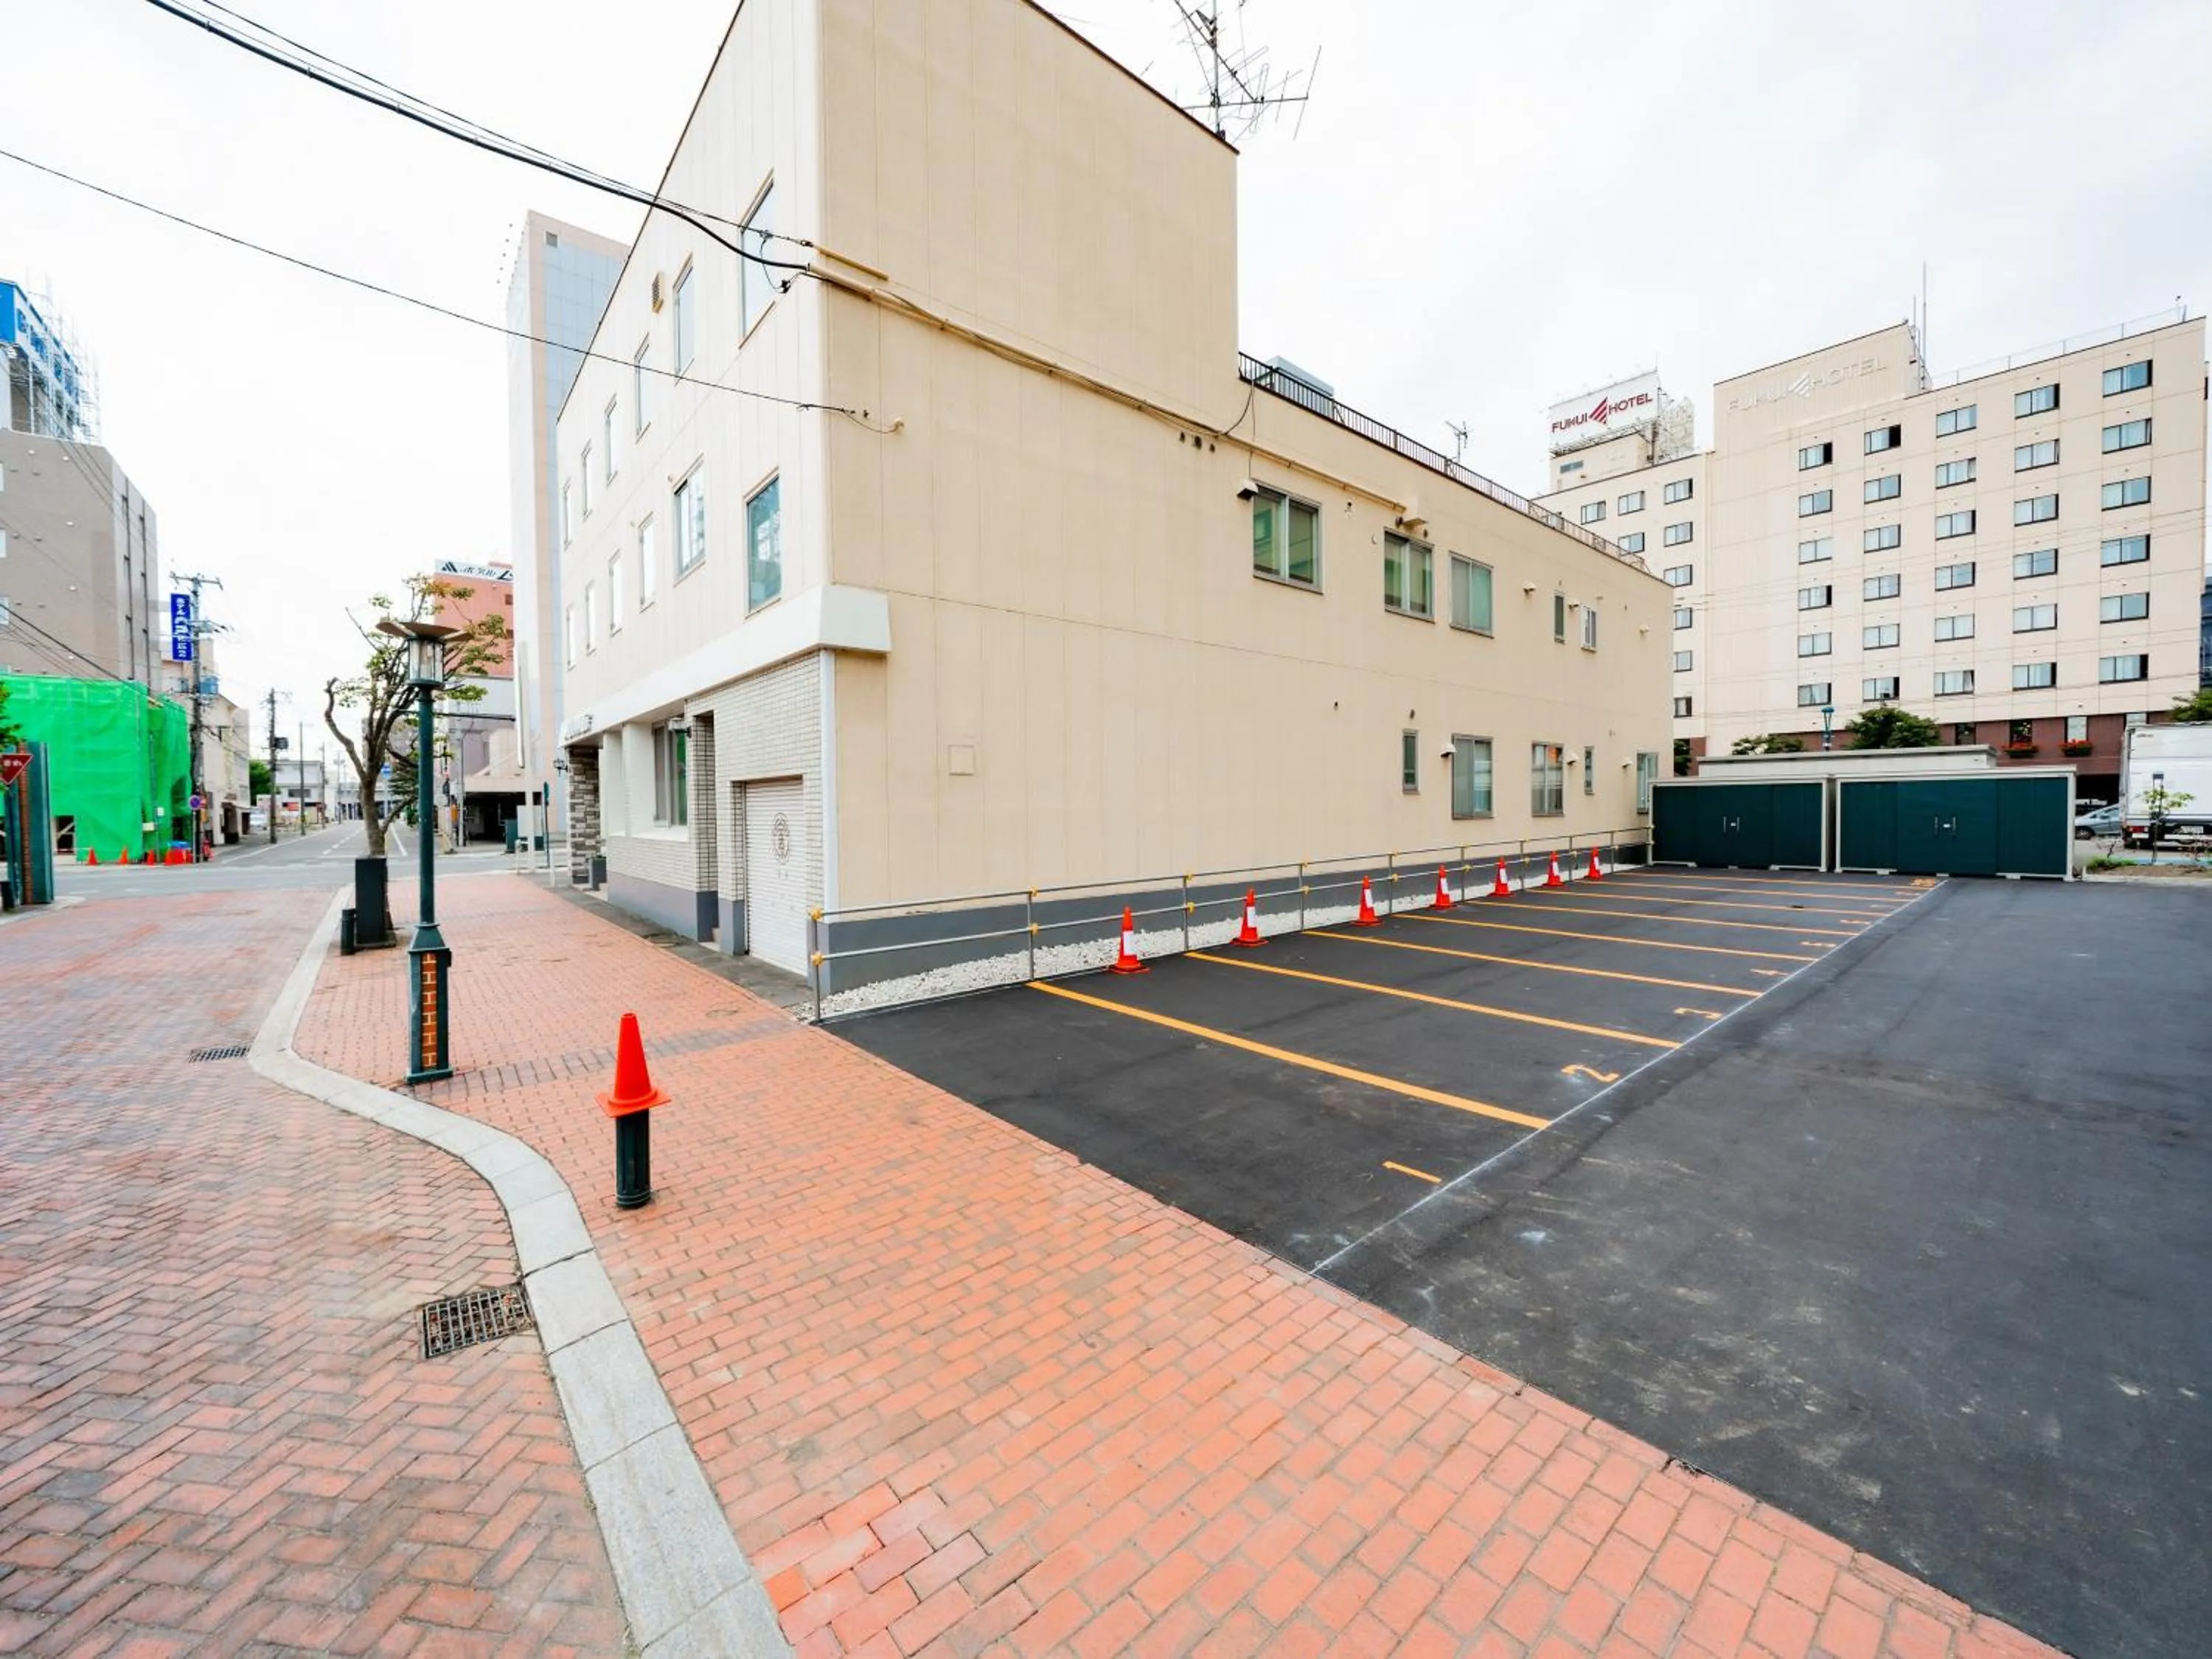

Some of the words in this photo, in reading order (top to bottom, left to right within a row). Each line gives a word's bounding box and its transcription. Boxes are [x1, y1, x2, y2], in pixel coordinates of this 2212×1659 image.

[1812, 355, 1888, 389] HOTEL
[1552, 412, 1587, 433] FUKUI
[1609, 393, 1653, 414] HOTEL
[1561, 1064, 1619, 1082] 2
